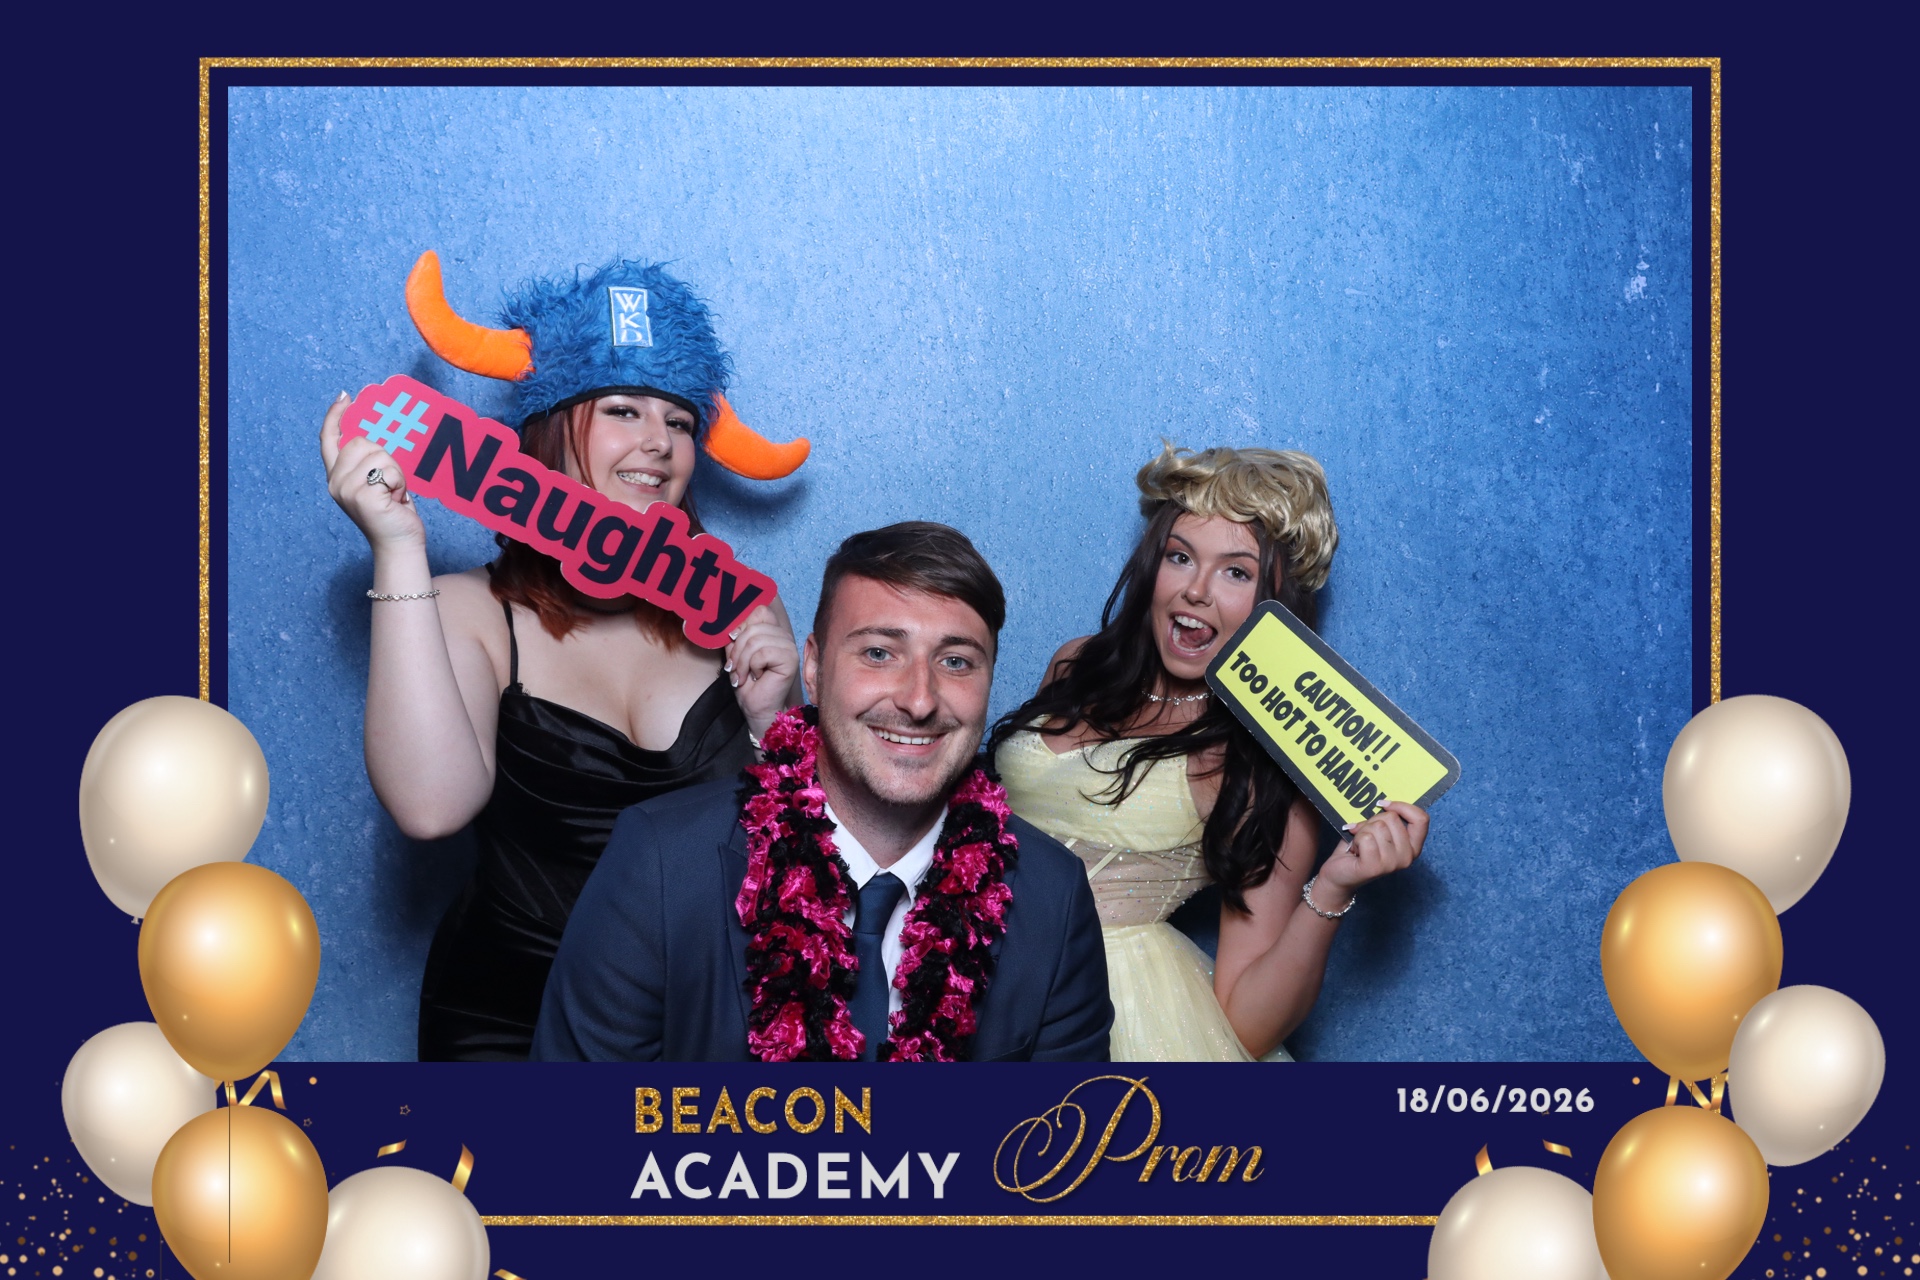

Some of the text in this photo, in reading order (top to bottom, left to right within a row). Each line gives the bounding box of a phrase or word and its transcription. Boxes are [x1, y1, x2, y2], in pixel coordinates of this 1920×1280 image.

[359, 391, 763, 636] #Naughty
[1230, 651, 1388, 819] TOO HOT TO HANDL
[1294, 671, 1401, 771] CAUTION!!
